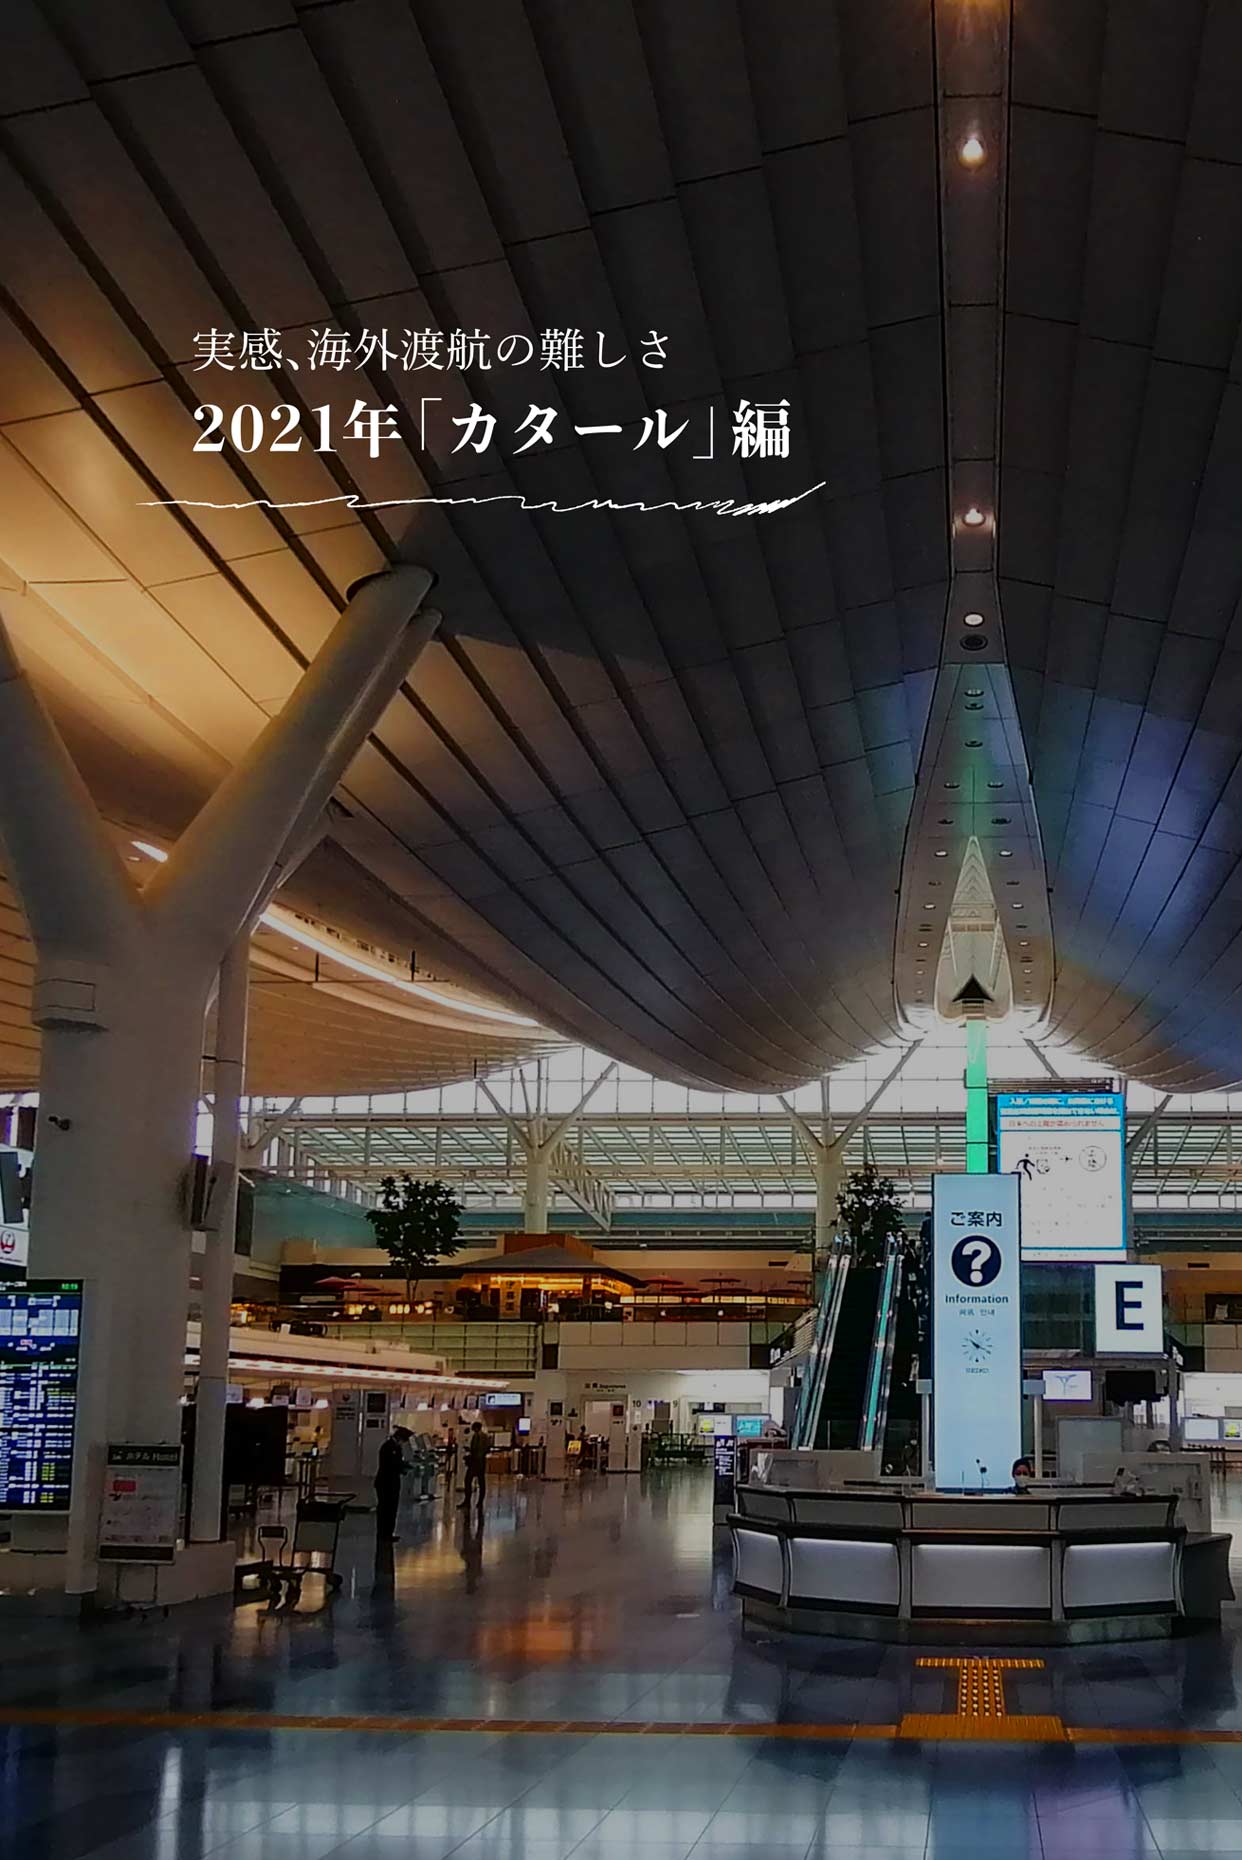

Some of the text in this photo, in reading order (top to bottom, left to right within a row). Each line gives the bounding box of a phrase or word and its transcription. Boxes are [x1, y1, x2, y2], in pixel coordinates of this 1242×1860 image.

[949, 1210, 1003, 1228] ご案内
[945, 1294, 1009, 1305] Information
[1115, 1281, 1144, 1331] E
